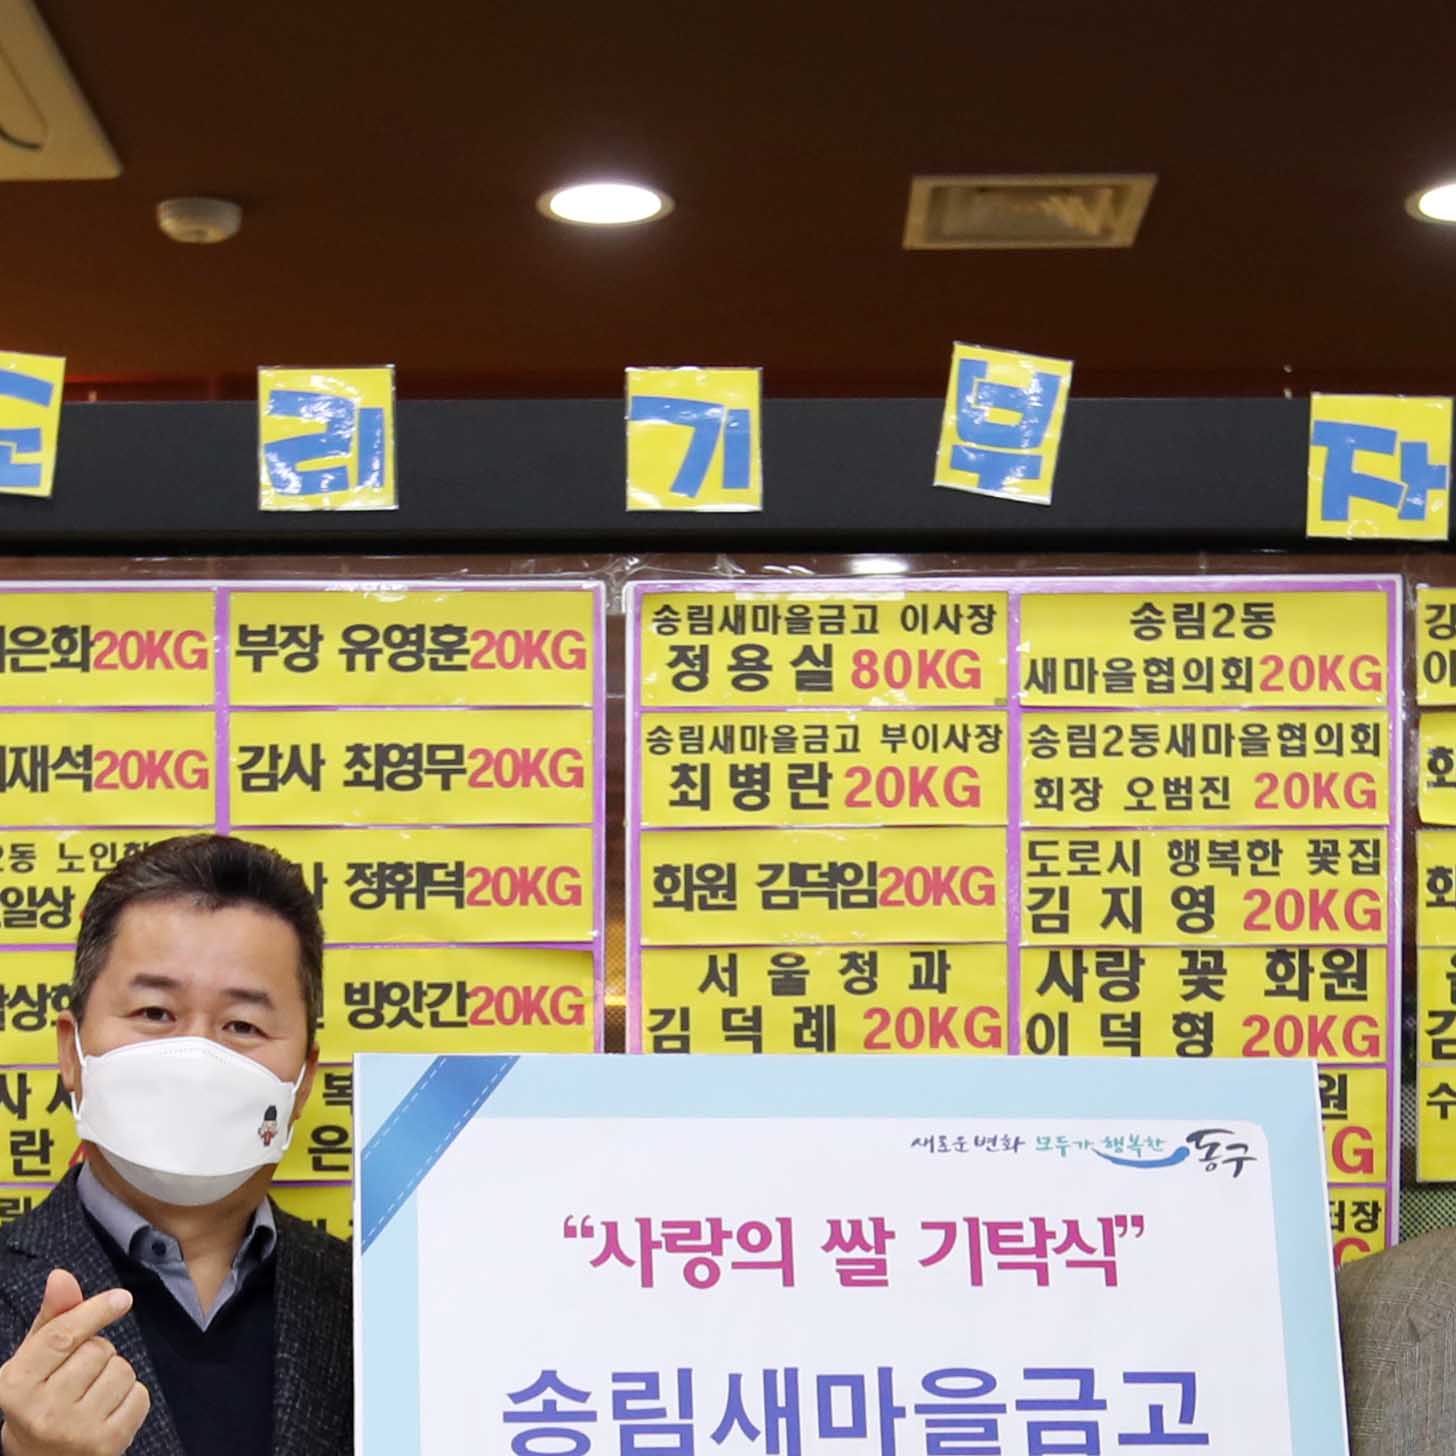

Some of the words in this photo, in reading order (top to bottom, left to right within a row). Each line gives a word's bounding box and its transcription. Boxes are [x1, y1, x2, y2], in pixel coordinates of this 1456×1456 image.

[653, 605, 878, 635] 송림새마을금고
[901, 604, 996, 634] 이사장
[1131, 602, 1275, 640] 송림2동
[95, 631, 207, 669] 20KG
[236, 624, 323, 672] 부장
[472, 630, 585, 669] 20KG
[853, 650, 980, 688] 80KG
[1025, 657, 1252, 693] 새마을협의회
[1261, 656, 1381, 690] 20KG
[647, 725, 859, 755] 송림새마을금고
[882, 725, 1002, 753] 부이사장
[95, 751, 208, 789] 20KG
[238, 744, 325, 792] 감사
[469, 749, 583, 787] 20KG
[847, 767, 979, 807] 20KG
[1035, 778, 1102, 811] 회장
[1125, 777, 1229, 810] 오범진
[1256, 773, 1375, 808] 20KG
[1028, 840, 1139, 876] 도로시
[1168, 840, 1282, 876] 행복한
[1308, 840, 1380, 875] 꽃집
[467, 867, 581, 906] 20KG
[654, 863, 736, 911] 회원
[880, 867, 994, 906] 20KG
[1244, 889, 1380, 930] 20KG
[1034, 946, 1148, 1002] 사랑
[1179, 950, 1227, 1001] 꽃
[1265, 946, 1372, 1001] 화원
[469, 986, 584, 1025] 20KG
[865, 1007, 1001, 1049] 20KG
[1243, 1015, 1379, 1056] 20KG
[1186, 1128, 1258, 1178] 동구
[822, 1216, 896, 1288] 쌀
